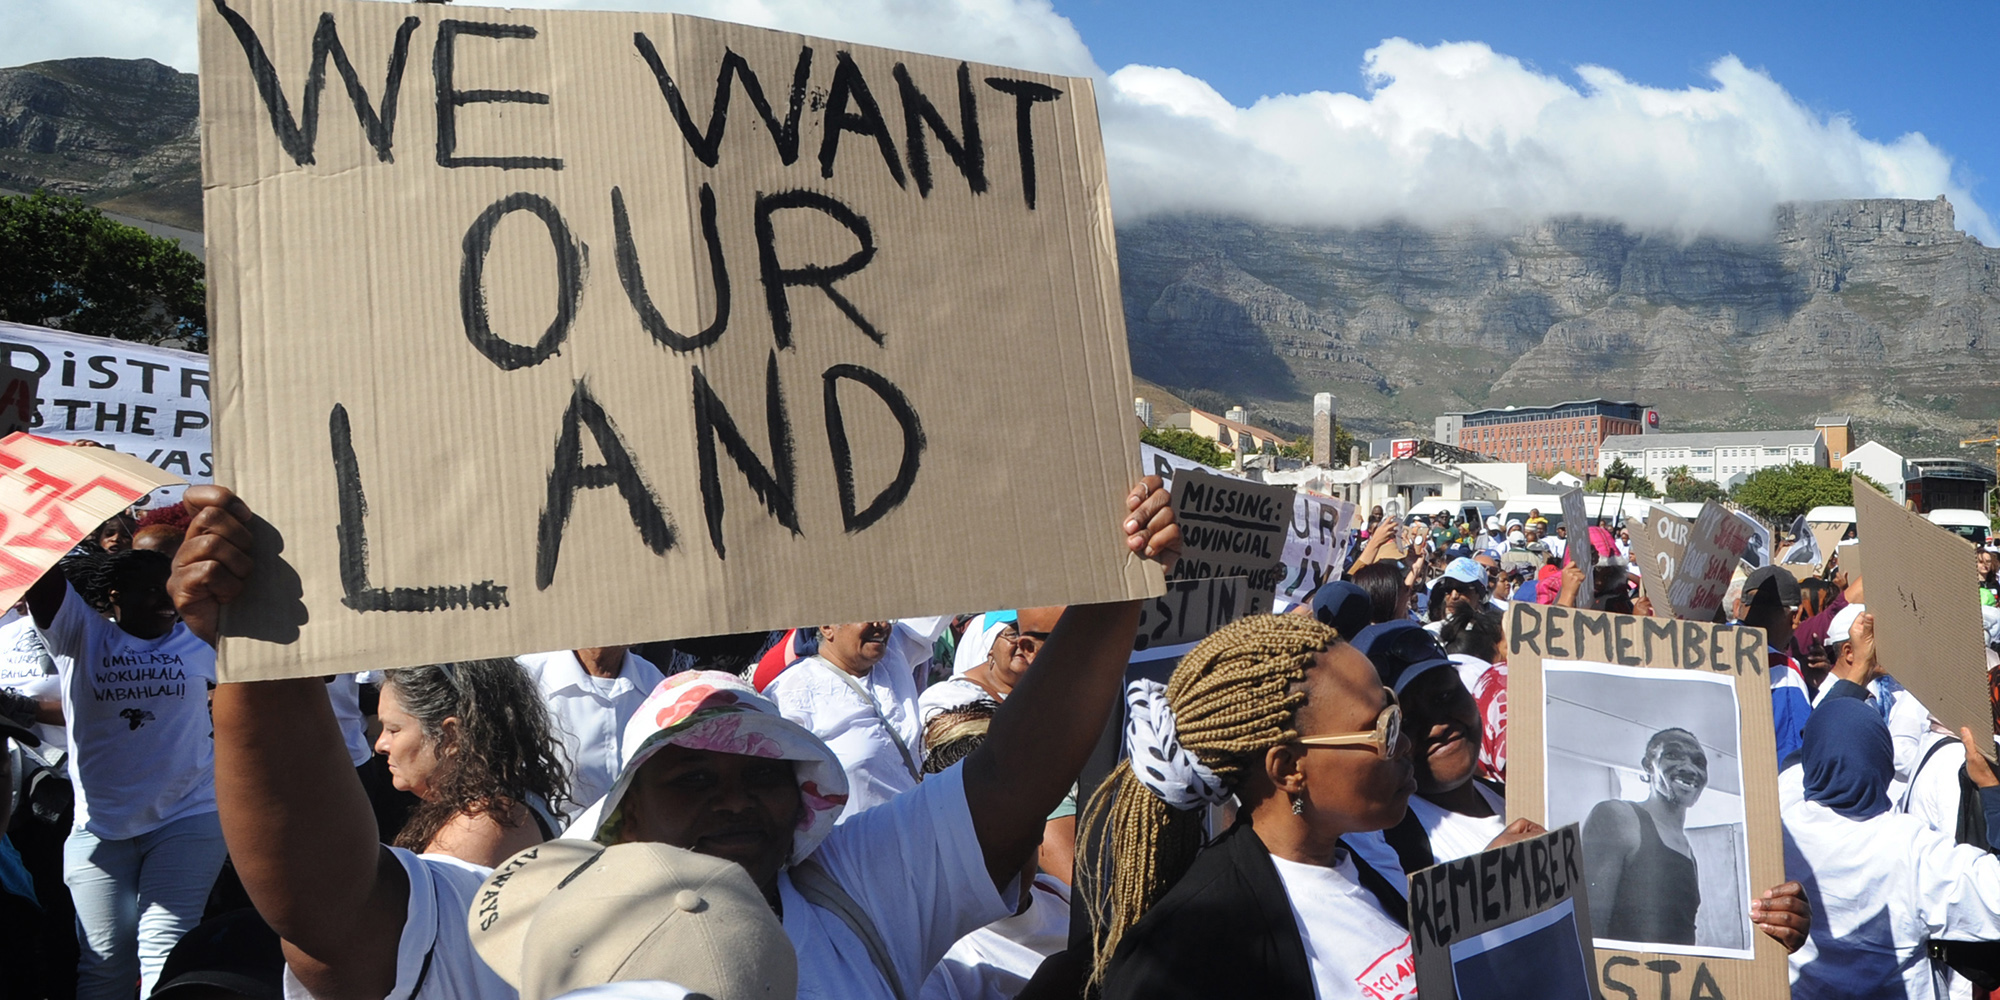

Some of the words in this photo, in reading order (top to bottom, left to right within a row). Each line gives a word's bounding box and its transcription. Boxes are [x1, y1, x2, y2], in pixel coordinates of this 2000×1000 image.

[213, 0, 567, 170] WE
[634, 32, 1064, 210] WANT
[459, 182, 887, 371] OUR
[329, 347, 927, 614] LAND
[1180, 480, 1282, 523] MISSING:
[1178, 522, 1271, 559] ROVINCIAL
[1657, 516, 1688, 546] OUR
[1165, 558, 1211, 580] AND
[102, 653, 184, 668] UMHLABA
[1510, 602, 1764, 677] REMEMBER
[95, 666, 186, 683] WOKUHLALA
[479, 847, 539, 932] ALWAYS
[1410, 828, 1579, 955] REMEMBER
